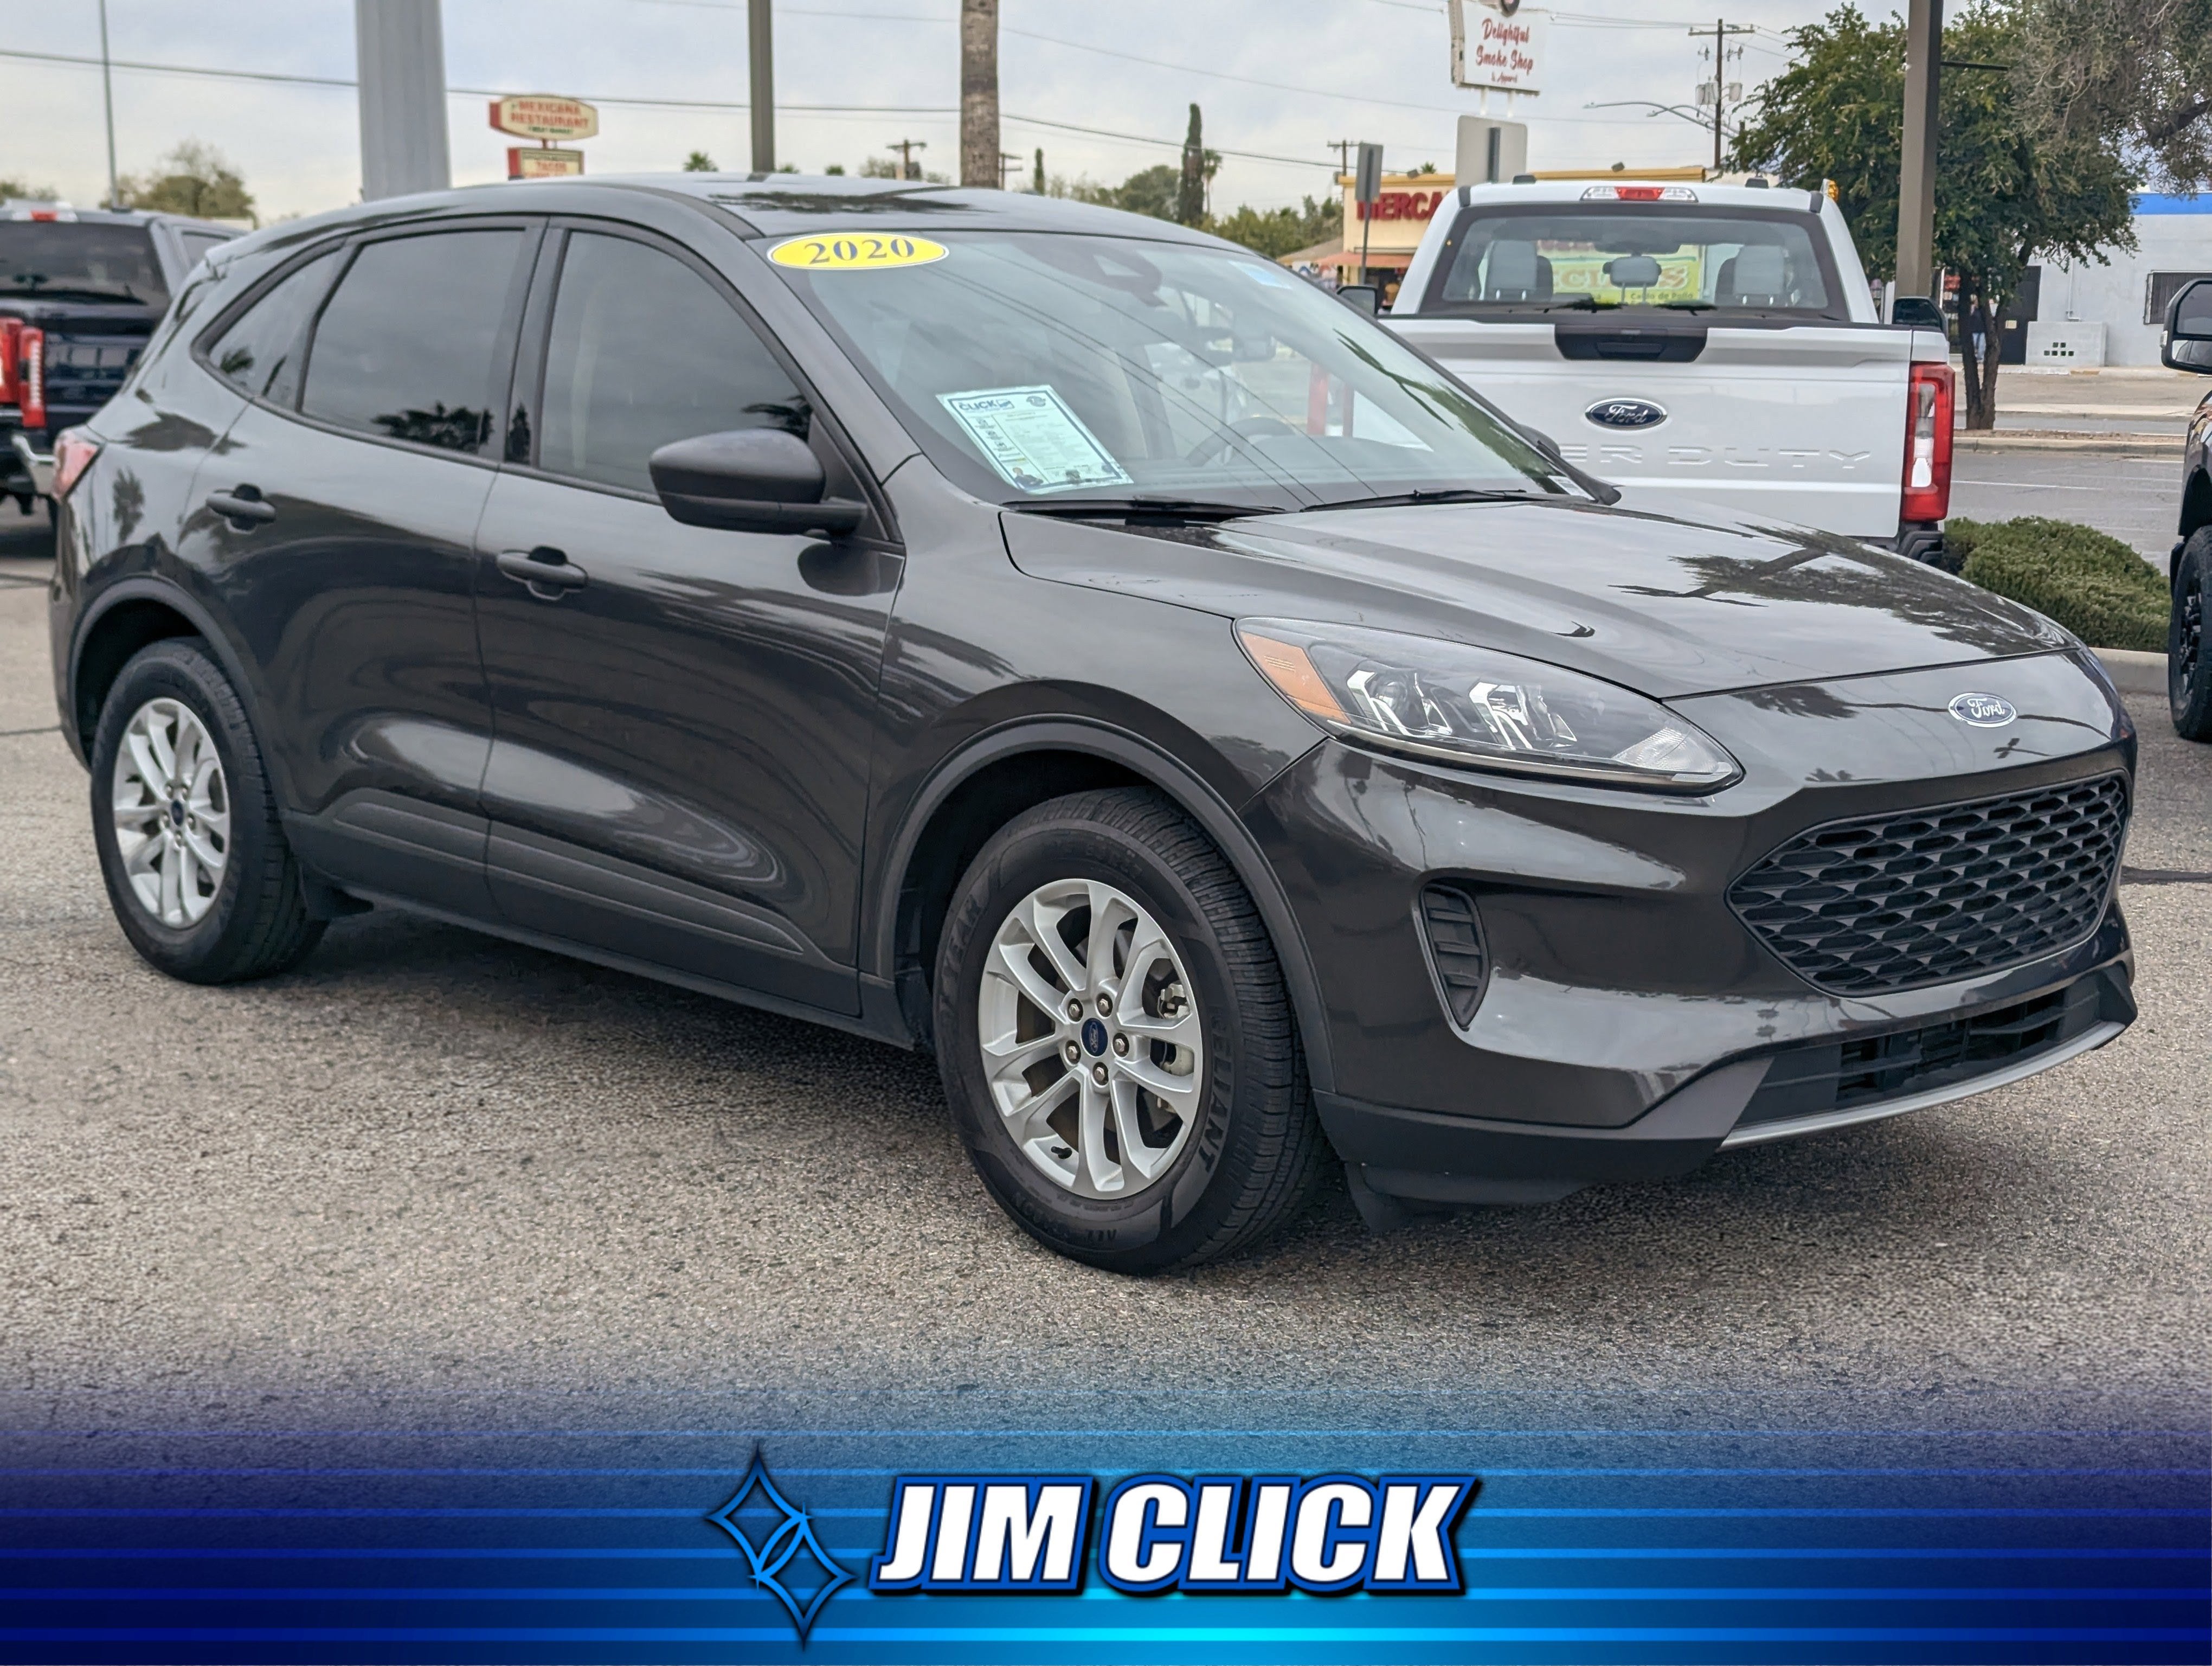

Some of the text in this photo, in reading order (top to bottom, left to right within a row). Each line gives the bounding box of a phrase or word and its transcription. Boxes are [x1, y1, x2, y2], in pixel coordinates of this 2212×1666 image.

[1482, 18, 1529, 46] Delightful
[1476, 44, 1534, 75] Smoke Shop
[803, 238, 915, 265] 2020
[959, 400, 998, 411] CLICK
[1605, 404, 1649, 423] Ford
[1667, 446, 1871, 469] DUTY
[1967, 697, 2005, 719] Ford
